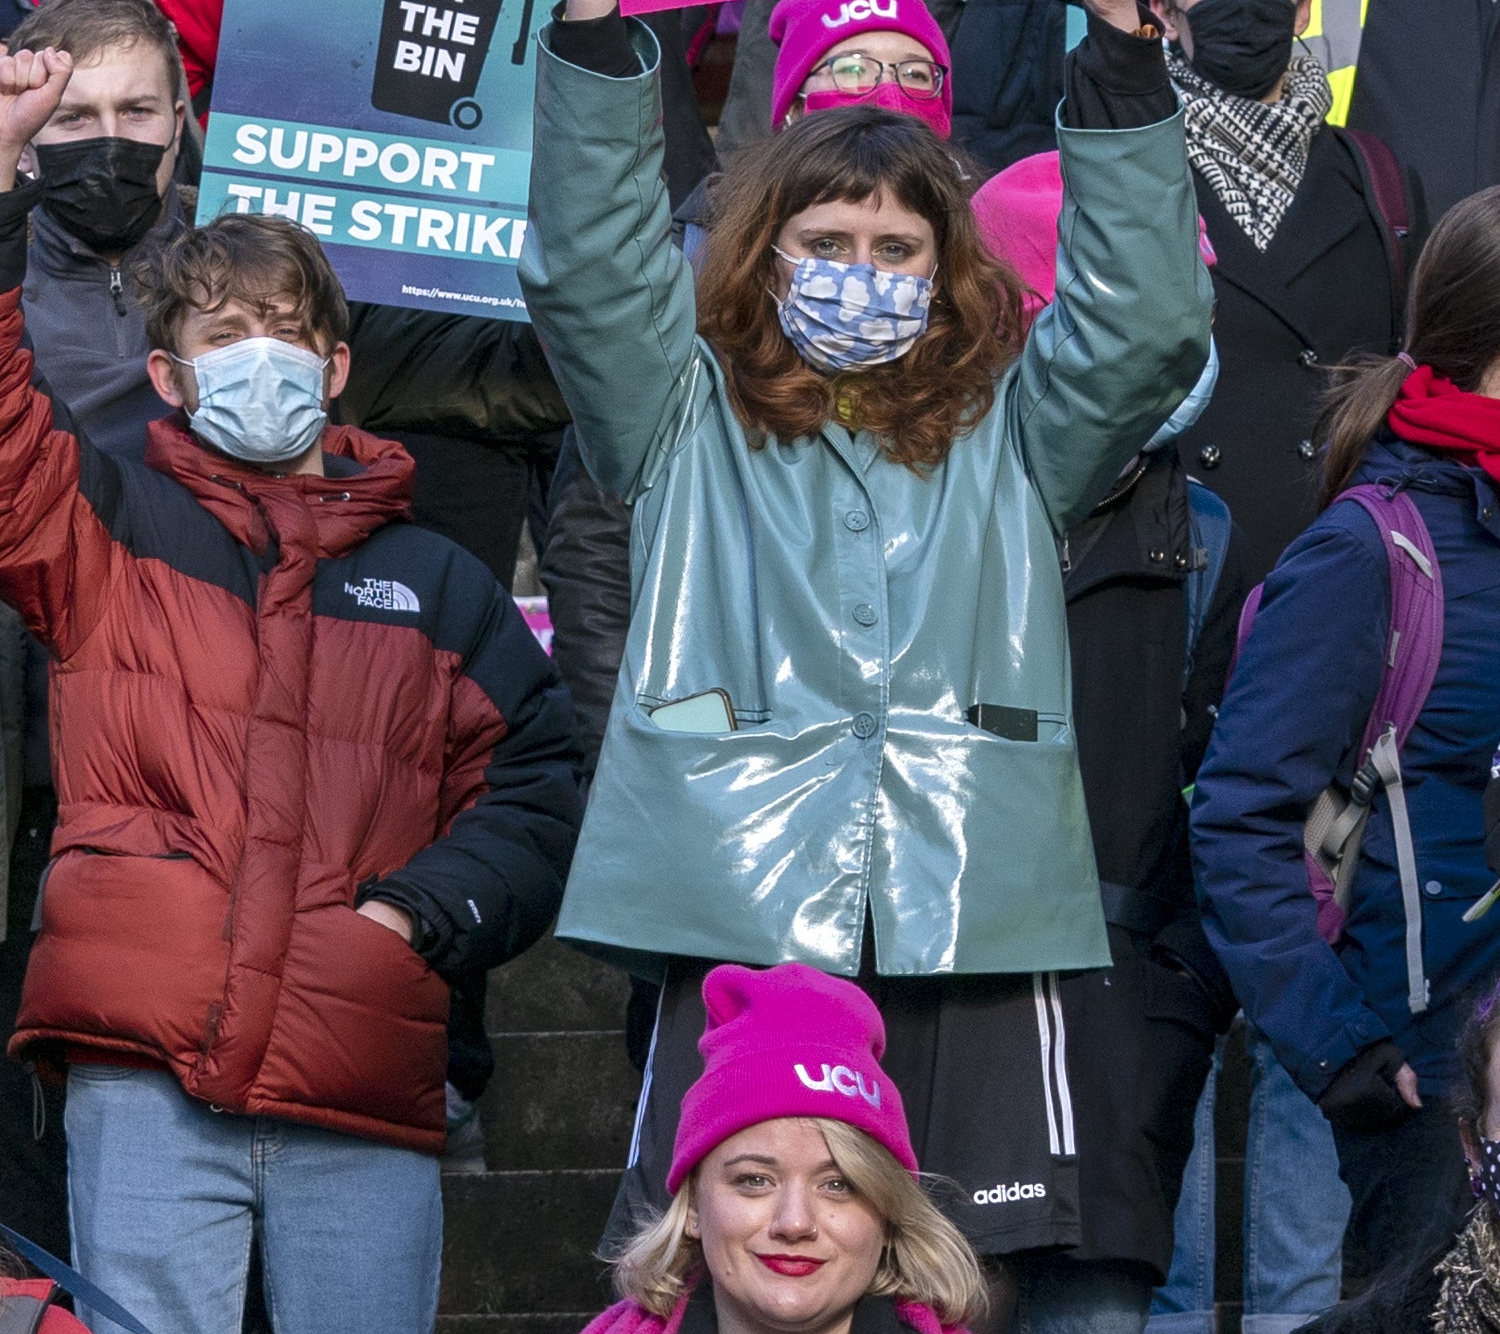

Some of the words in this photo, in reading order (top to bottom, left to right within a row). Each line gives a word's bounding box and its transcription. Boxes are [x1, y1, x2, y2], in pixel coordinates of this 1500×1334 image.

[399, 0, 480, 46] THE
[393, 43, 466, 83] BIN
[232, 123, 495, 193] SUPPORT
[344, 581, 391, 599] NORTH
[363, 578, 391, 590] THE
[357, 594, 393, 609] FACE
[794, 1063, 882, 1110] UCU
[973, 1181, 1046, 1205] adidas
